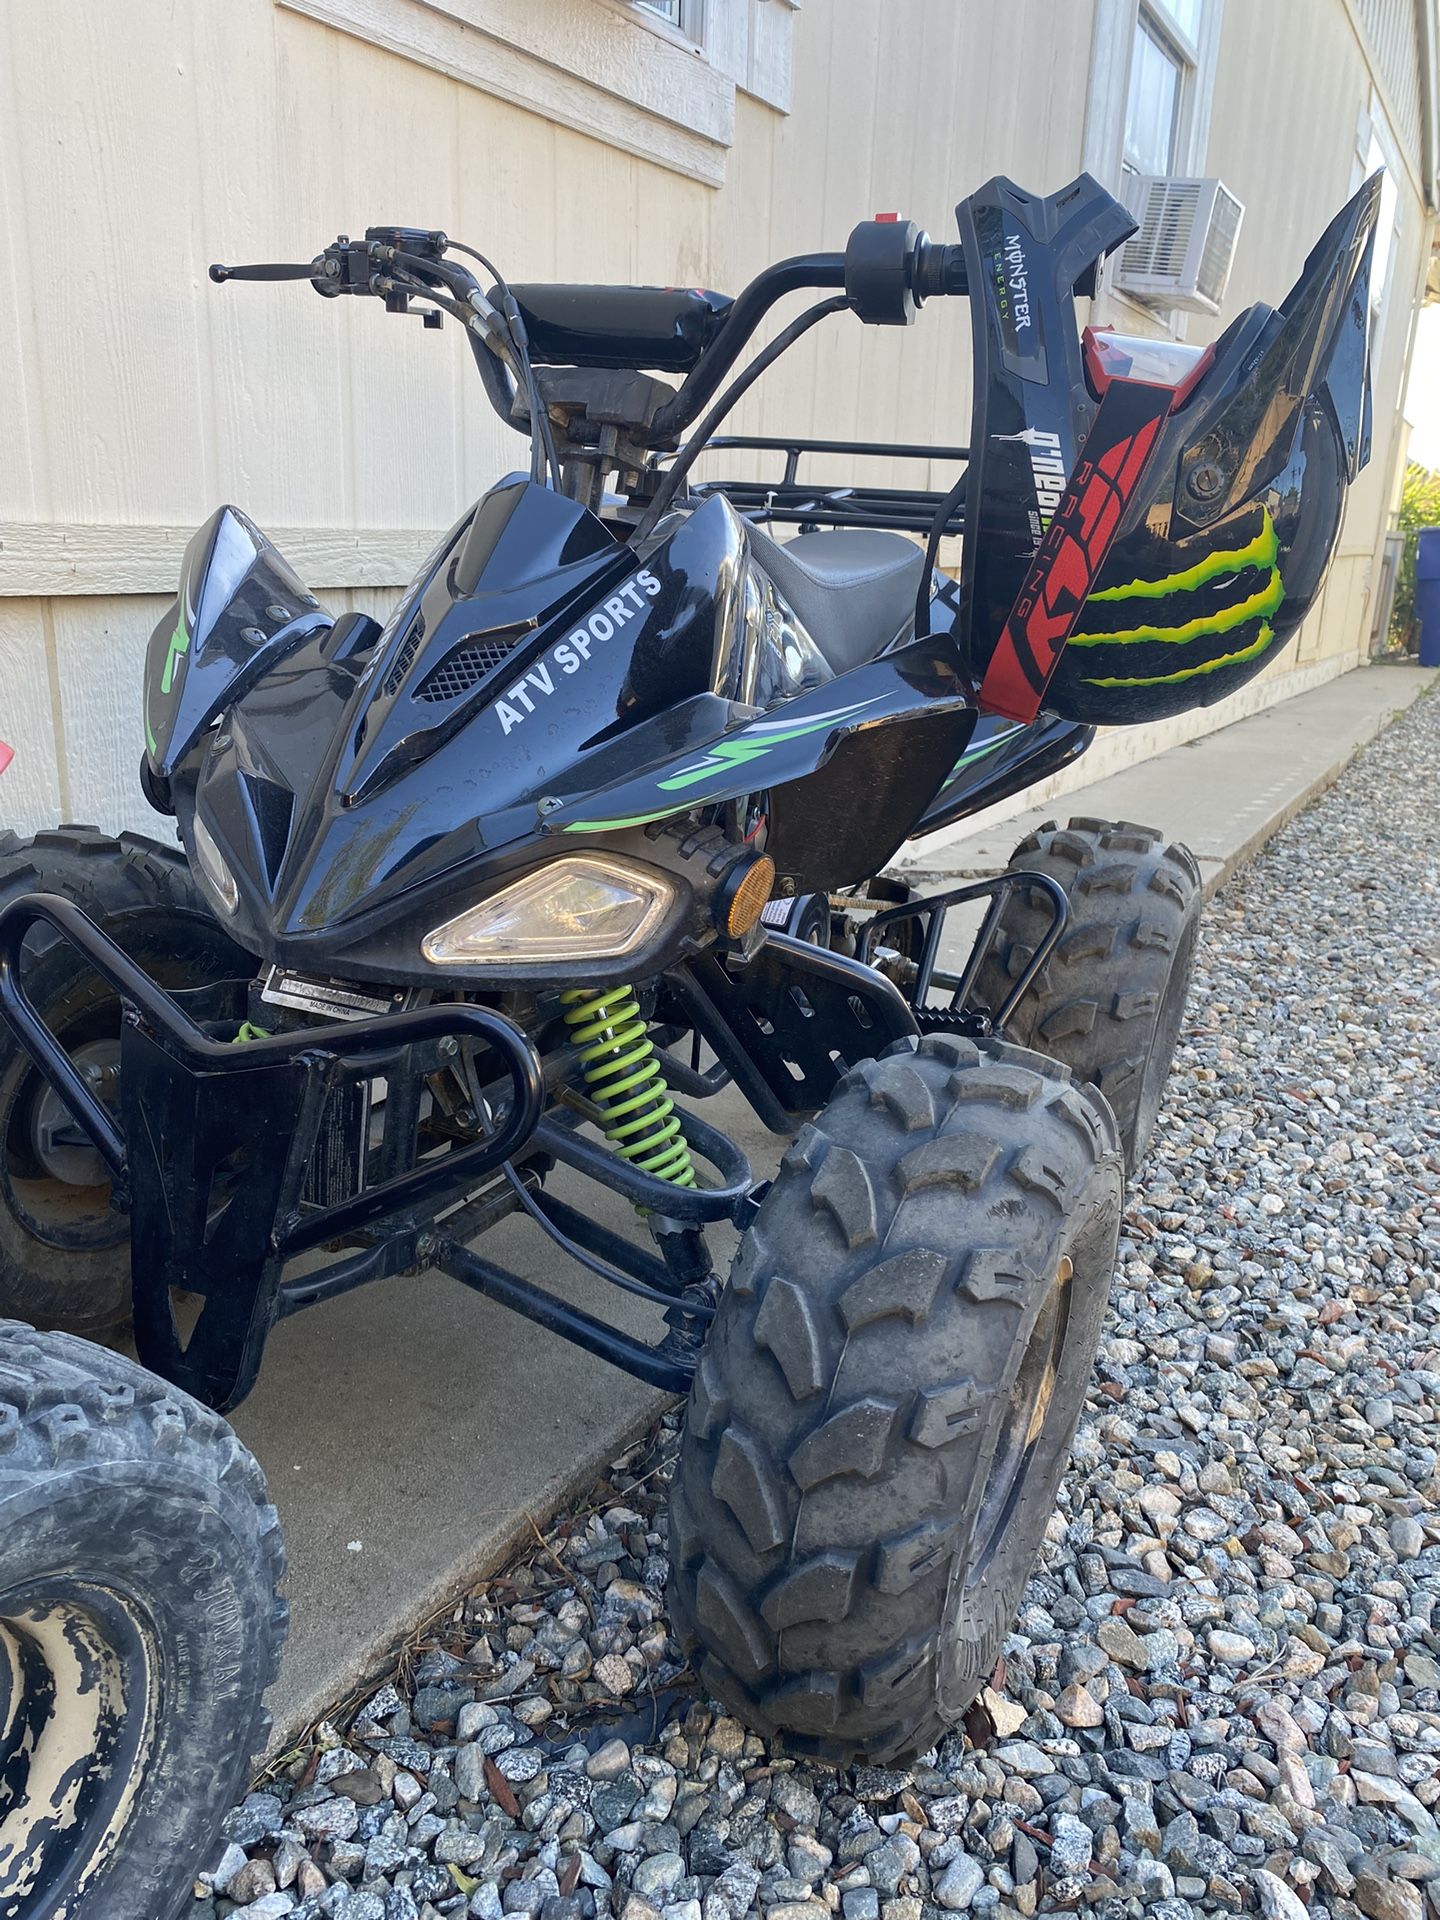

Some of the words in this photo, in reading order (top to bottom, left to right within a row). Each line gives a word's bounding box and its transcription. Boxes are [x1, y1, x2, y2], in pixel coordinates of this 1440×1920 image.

[994, 252, 1009, 319] ENERGY
[1004, 234, 1031, 332] MONSTER
[1016, 460, 1092, 618] RACING
[494, 662, 555, 736] ATV
[553, 569, 662, 674] SPORTS
[309, 1001, 327, 1012] MADE
[326, 1003, 332, 1012] IN
[332, 1004, 351, 1016] CHINA
